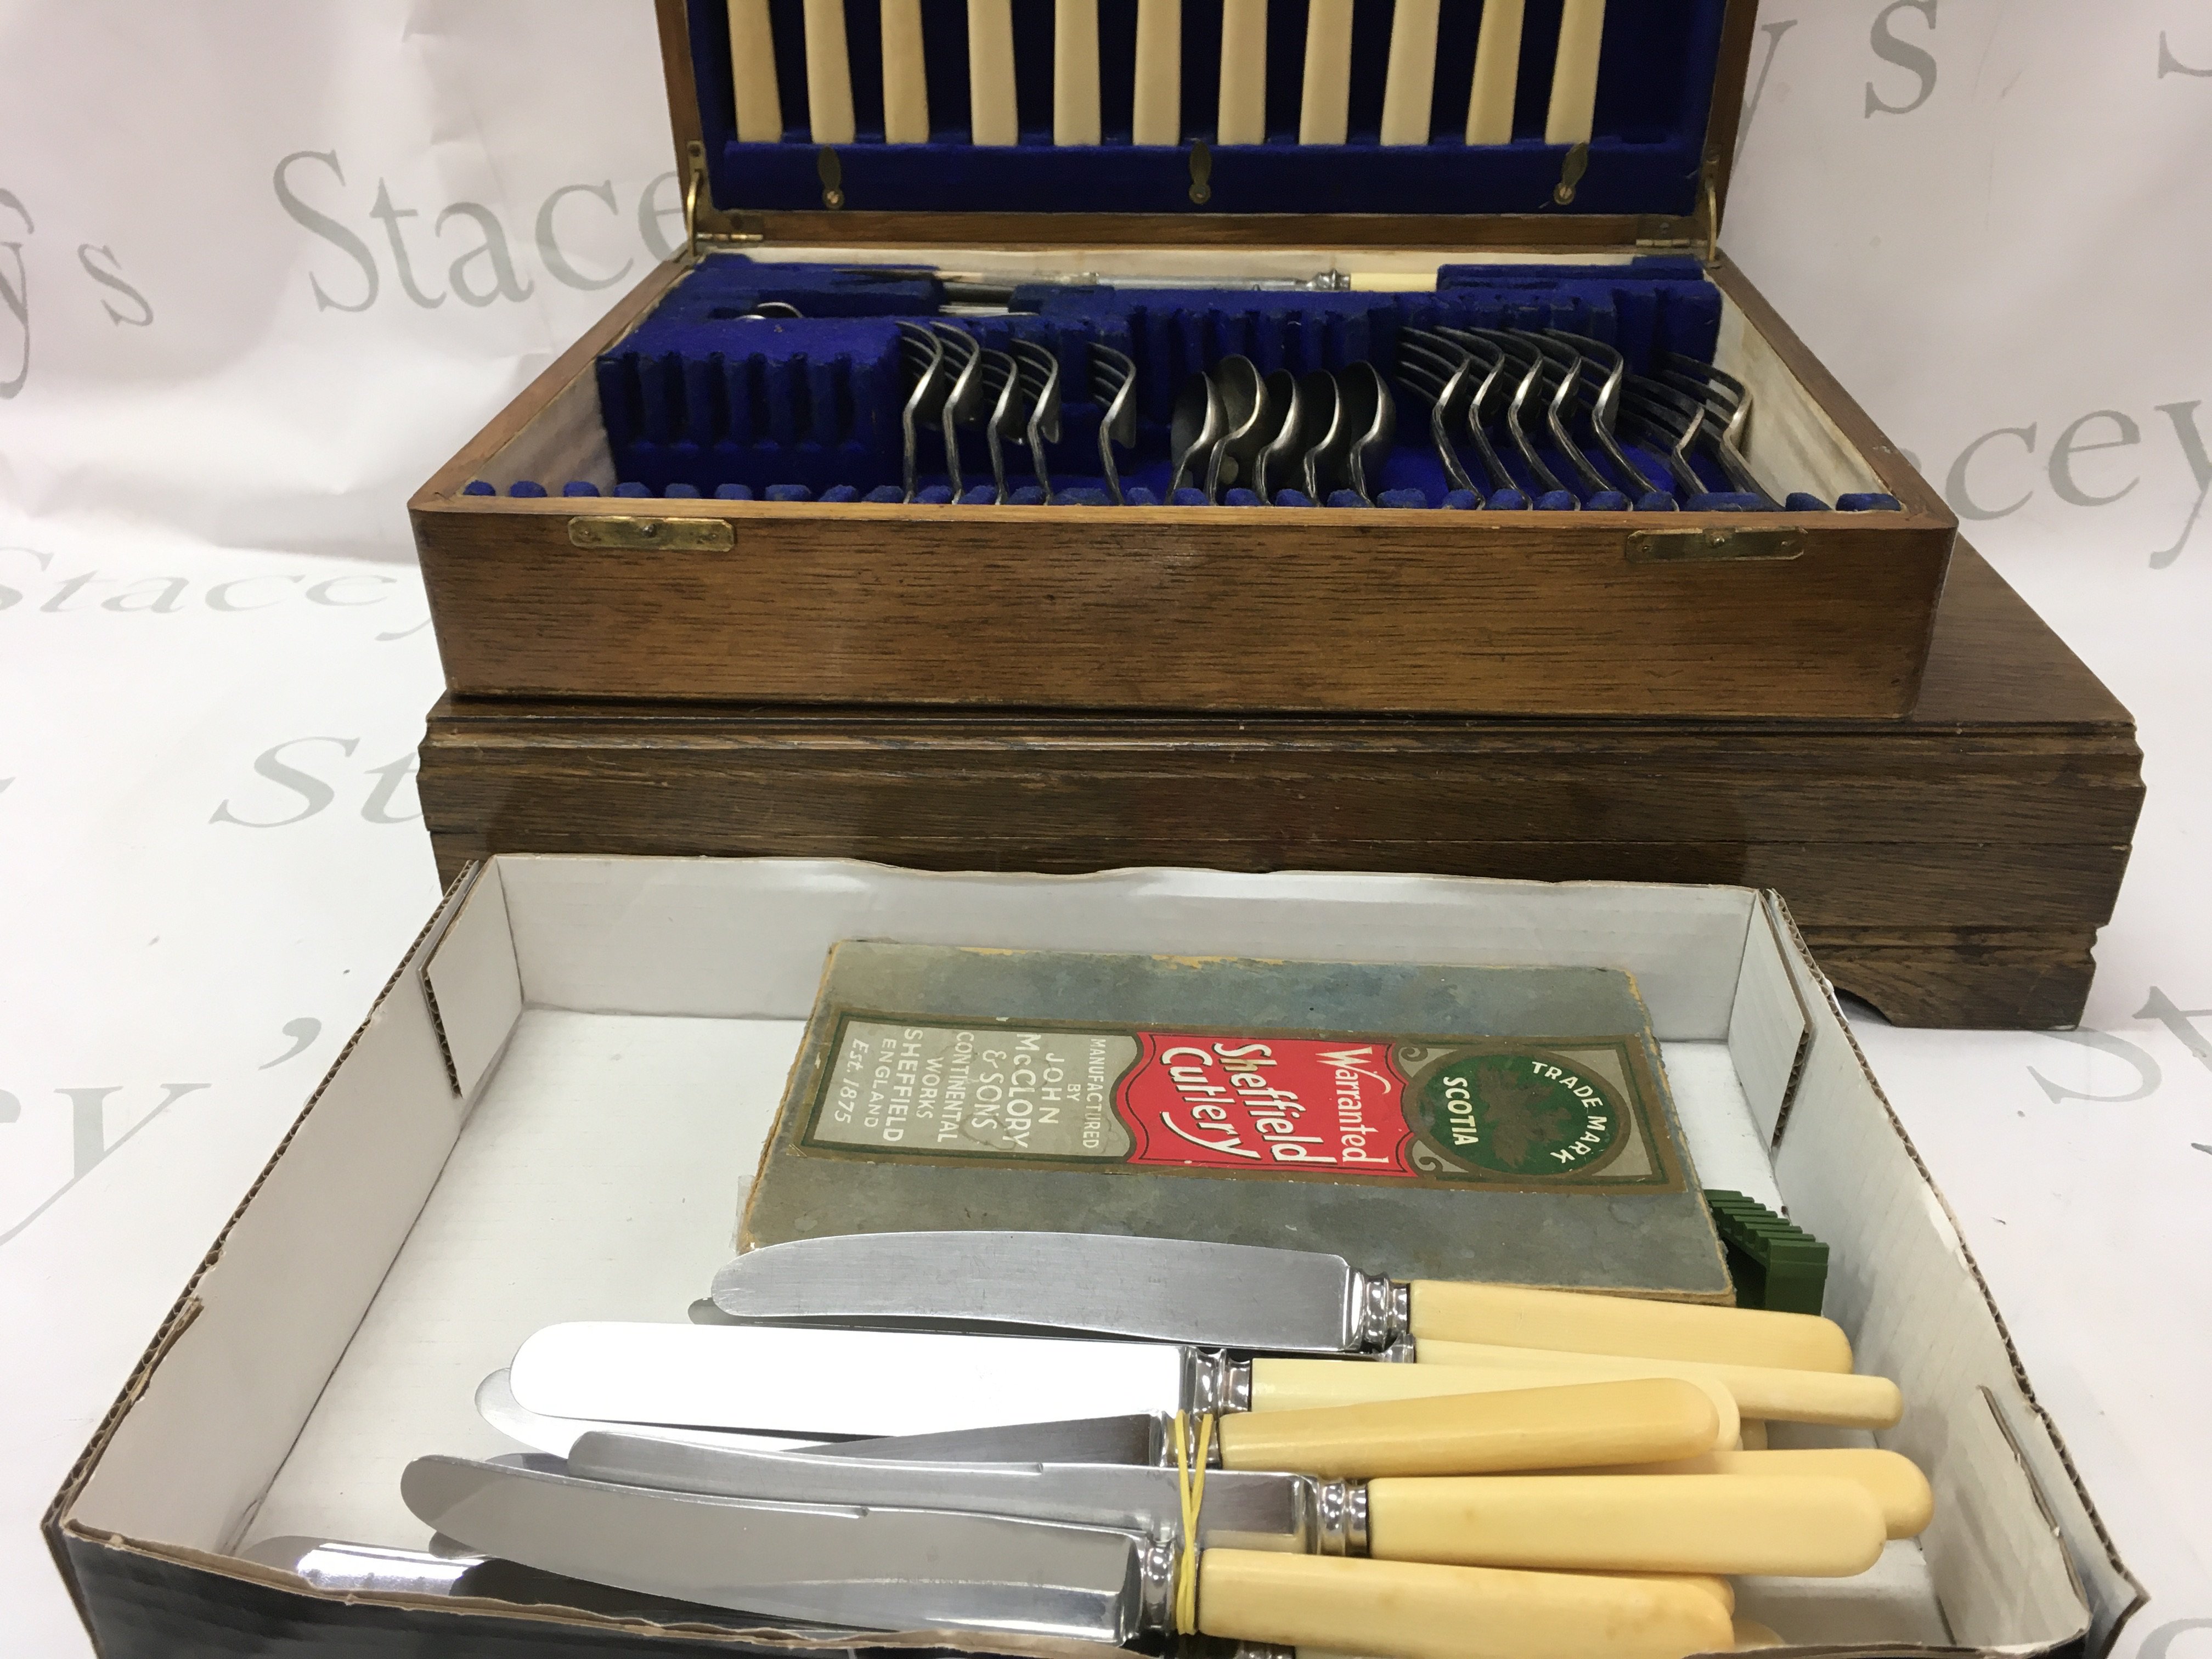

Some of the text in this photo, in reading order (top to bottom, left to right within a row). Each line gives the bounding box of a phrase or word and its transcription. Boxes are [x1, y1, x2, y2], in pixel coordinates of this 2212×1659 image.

[833, 1039, 870, 1124] Est. 1875
[864, 1038, 897, 1128] ENGLAND
[882, 1028, 924, 1142] SHEFFIELD
[916, 1056, 944, 1119] WORKS
[936, 1031, 975, 1143] CONTINENTAL
[971, 1049, 1007, 1130] & SONS
[1002, 1032, 1042, 1149] McCLORY
[1037, 1053, 1065, 1124] JOHN
[1065, 1084, 1081, 1102] BY
[1082, 1039, 1107, 1149] MANUFACTURED
[1159, 1047, 1262, 1160] Cutlery
[1212, 1042, 1338, 1164] Sheffield
[1315, 1046, 1391, 1163] Warranted
[1443, 1076, 1479, 1146] SCOTIA
[1531, 1061, 1607, 1164] TRADE MARK
